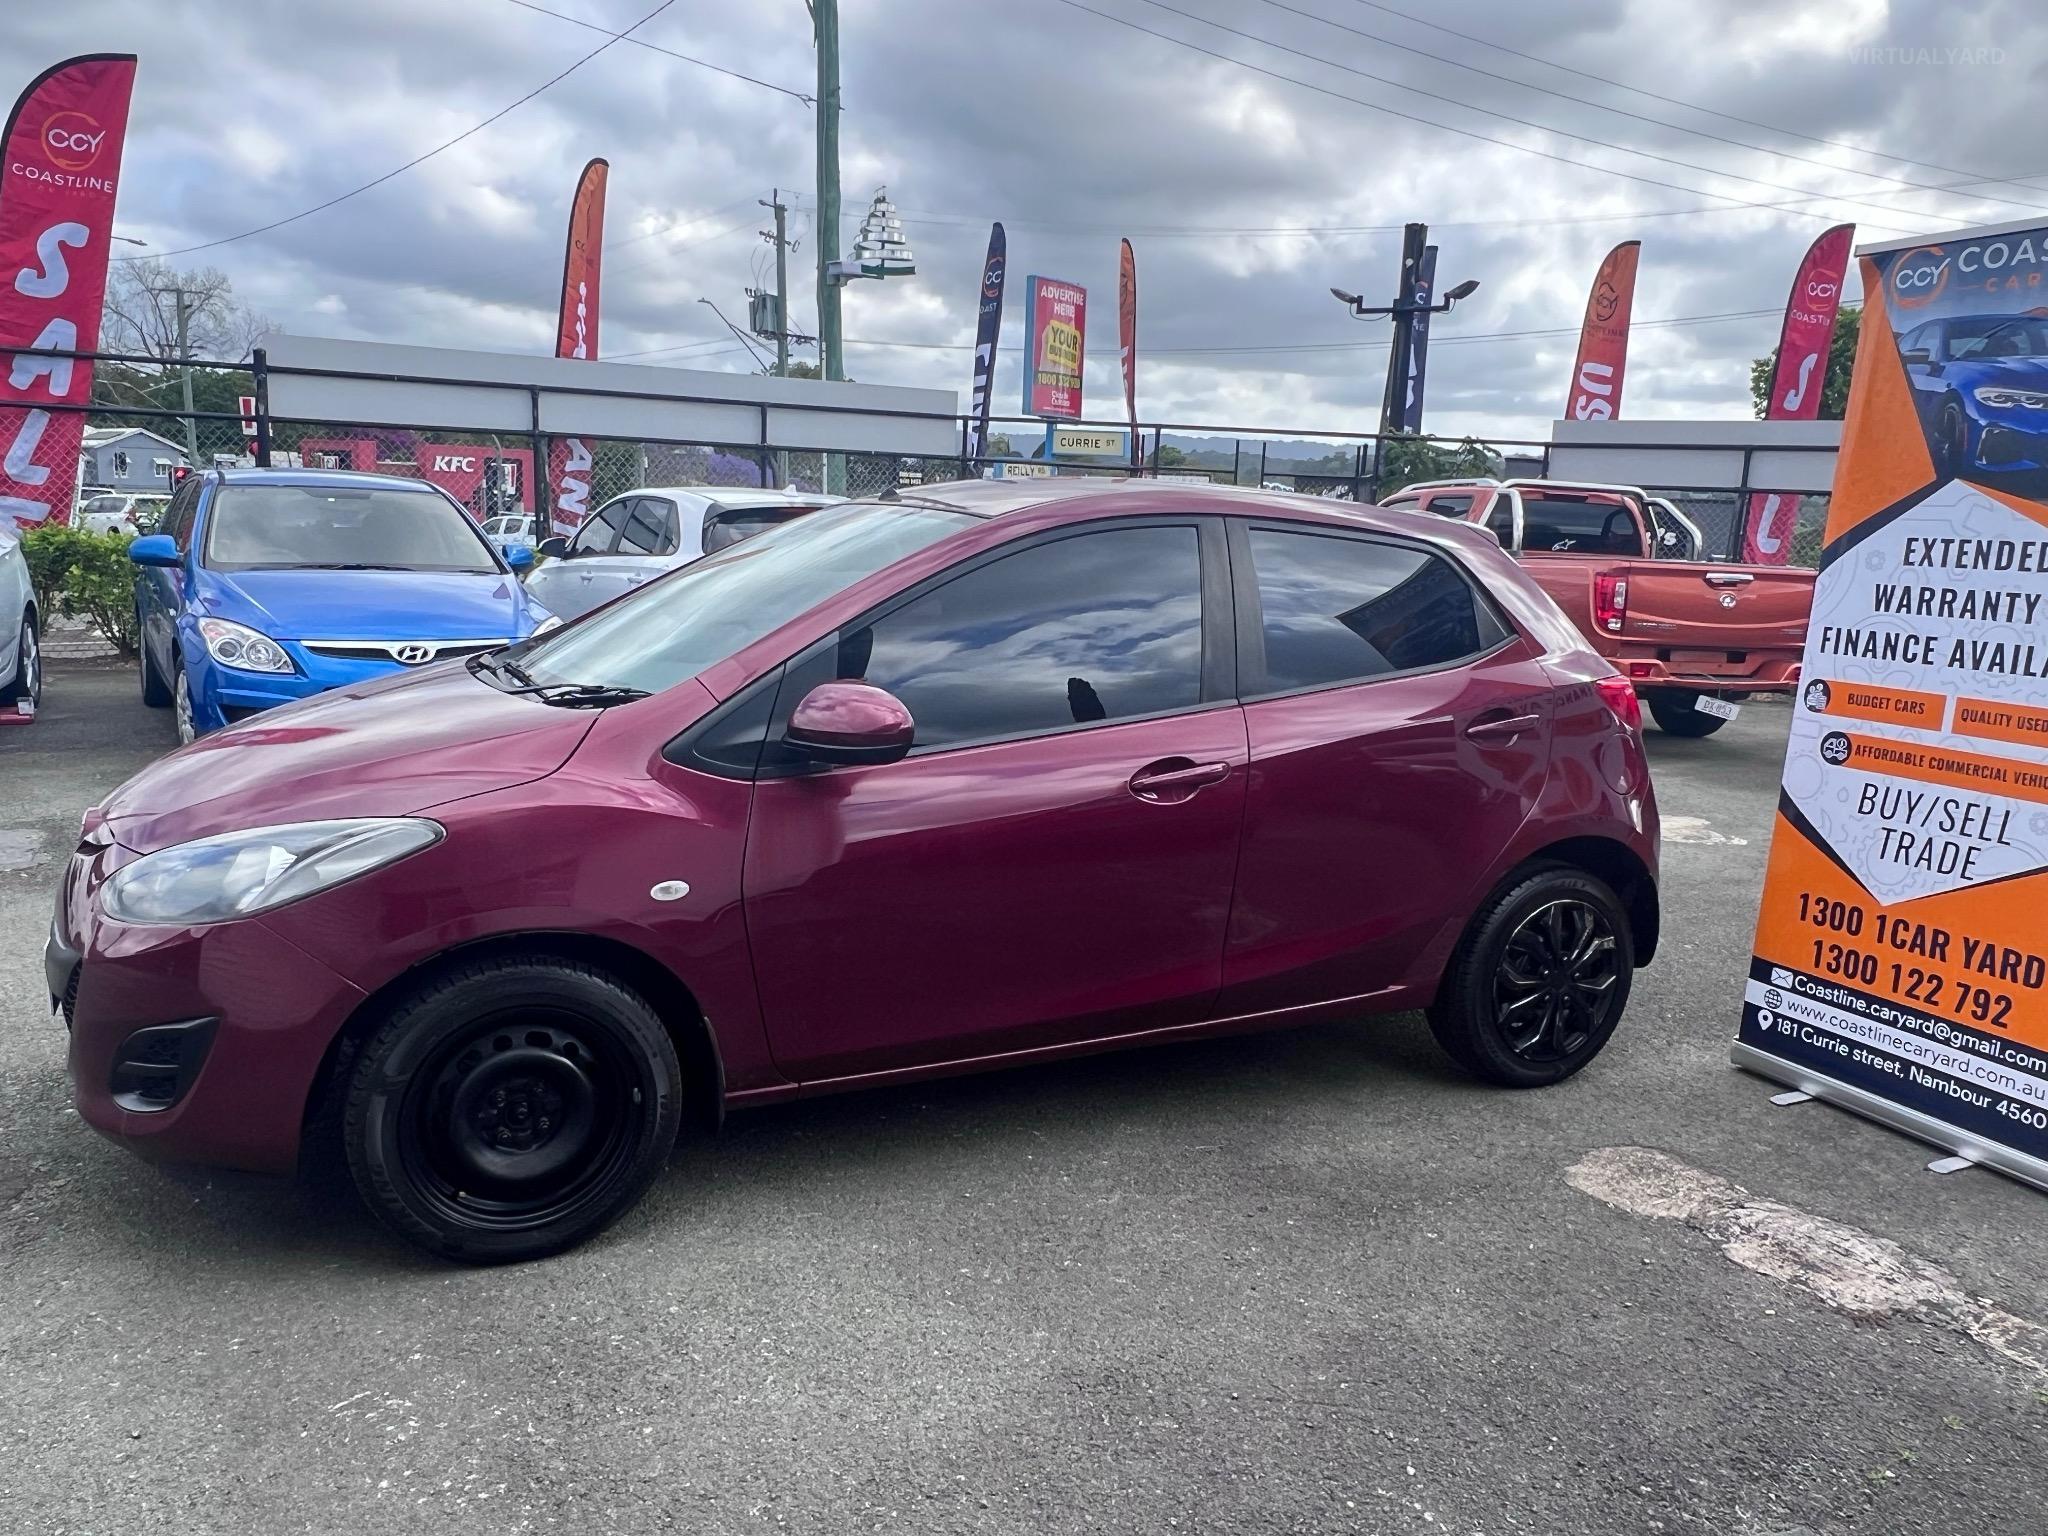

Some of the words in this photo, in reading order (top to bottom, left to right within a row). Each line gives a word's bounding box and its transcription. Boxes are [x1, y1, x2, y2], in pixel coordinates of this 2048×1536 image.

[48, 128, 106, 153] CCY
[12, 163, 113, 193] COASTLINE
[1895, 258, 1951, 289] CCY
[1985, 272, 2042, 293] CAR
[1040, 285, 1084, 306] ADVERTISE
[1054, 303, 1075, 318] HERE
[1051, 325, 1078, 352] YOUR
[1060, 437, 1101, 449] CURRIE
[1106, 439, 1116, 447] ST
[433, 455, 476, 473] KFC
[1007, 465, 1034, 477] REILLY
[1874, 583, 2042, 625] WARRANTY
[1820, 626, 1939, 666] FINANCE
[1847, 692, 1891, 711] BUDGET
[1894, 700, 1926, 715] CARS
[1960, 708, 2012, 728] QUALITY
[2017, 716, 2048, 733] USED
[1854, 744, 1924, 768] AFFORDABLE
[1928, 756, 2007, 783] COMMERCIAL
[1858, 783, 2012, 846] BUY/SELL
[1879, 826, 1982, 881] TRADE
[1799, 892, 1864, 937] 1300
[1876, 914, 1951, 963] 1CAR
[1963, 936, 2046, 990] YARD
[1814, 940, 1878, 985] 1300
[1891, 963, 1944, 1007] 122
[1956, 981, 2013, 1030] 792
[1795, 976, 2047, 1073] Coastline.caryard@gmail.com
[1787, 1000, 2046, 1101] www.coastlinecaryard.com.au
[1776, 1017, 1799, 1038] 181
[1801, 1024, 1849, 1057] Currie
[1852, 1049, 1905, 1079] street,
[1909, 1069, 1993, 1108] Nambour
[1996, 1099, 2047, 1129] 4560
